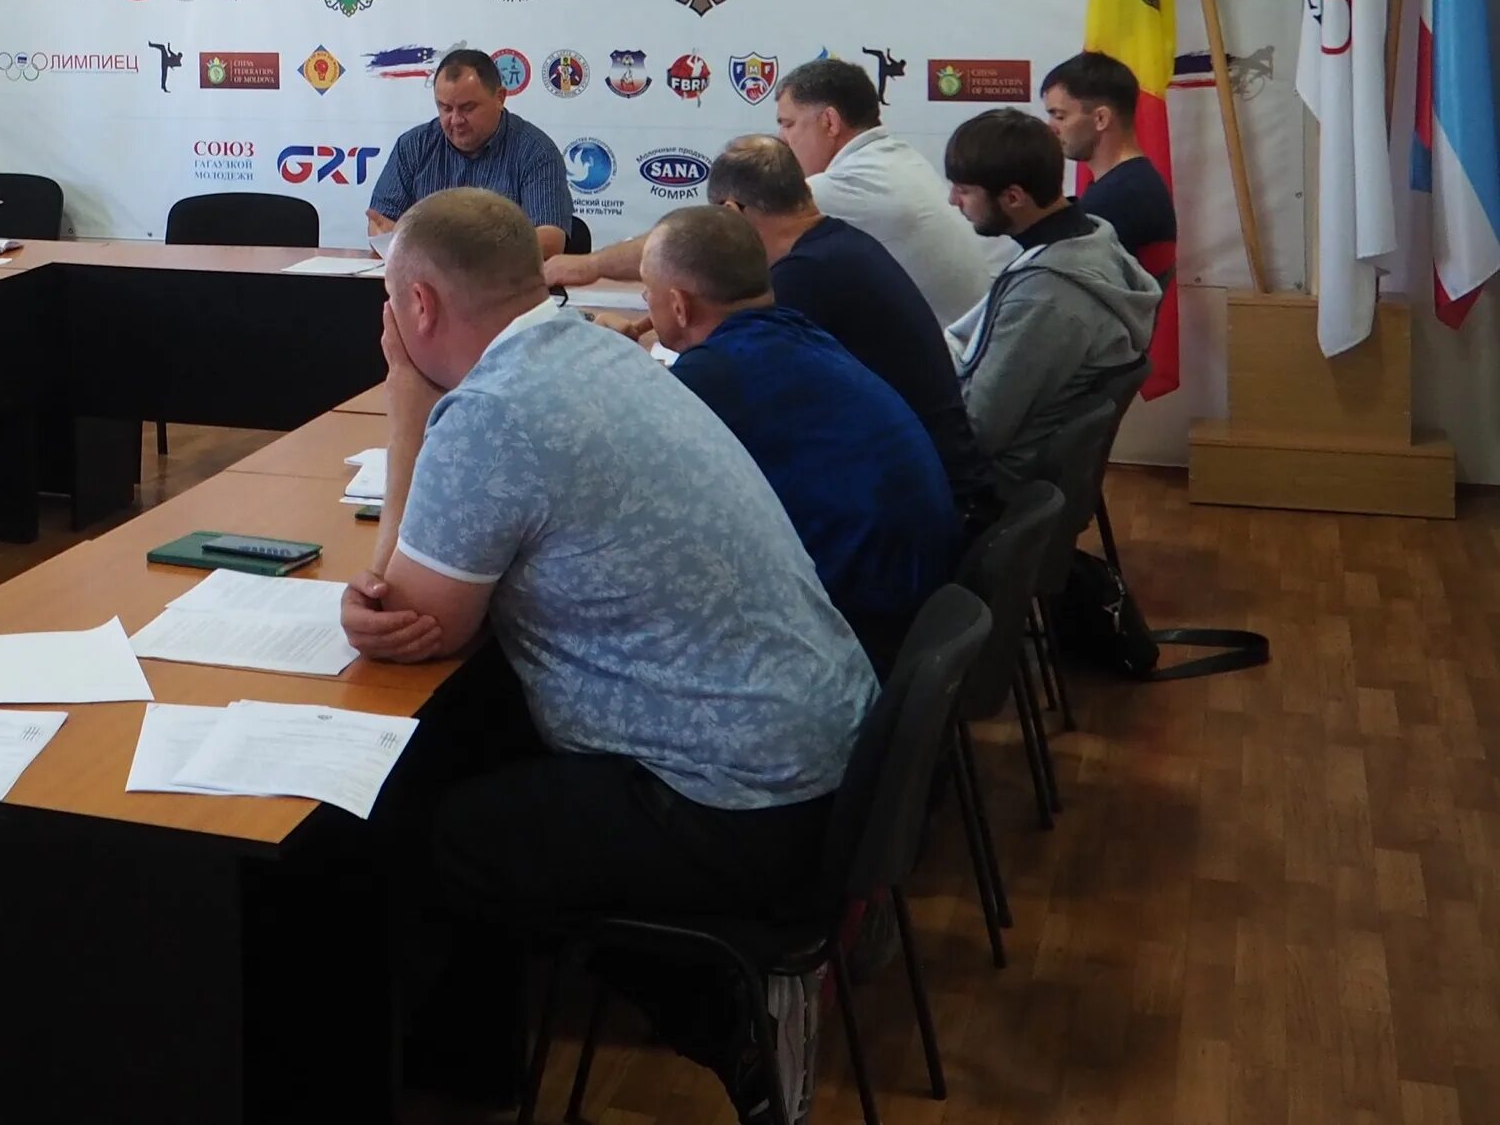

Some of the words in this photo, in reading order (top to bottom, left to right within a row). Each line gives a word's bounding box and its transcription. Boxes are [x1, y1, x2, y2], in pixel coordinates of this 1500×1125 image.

[736, 64, 772, 75] FMF
[194, 141, 254, 157] СОЮЗ
[636, 146, 677, 163] Молочные
[277, 145, 380, 185] GRT
[651, 162, 700, 178] SANA
[194, 171, 254, 180] МОЛОДЕЖИ
[650, 185, 699, 200] КОМРАТ
[573, 198, 600, 206] ИЙСКИЙ
[601, 200, 625, 208] ЦЕНТР
